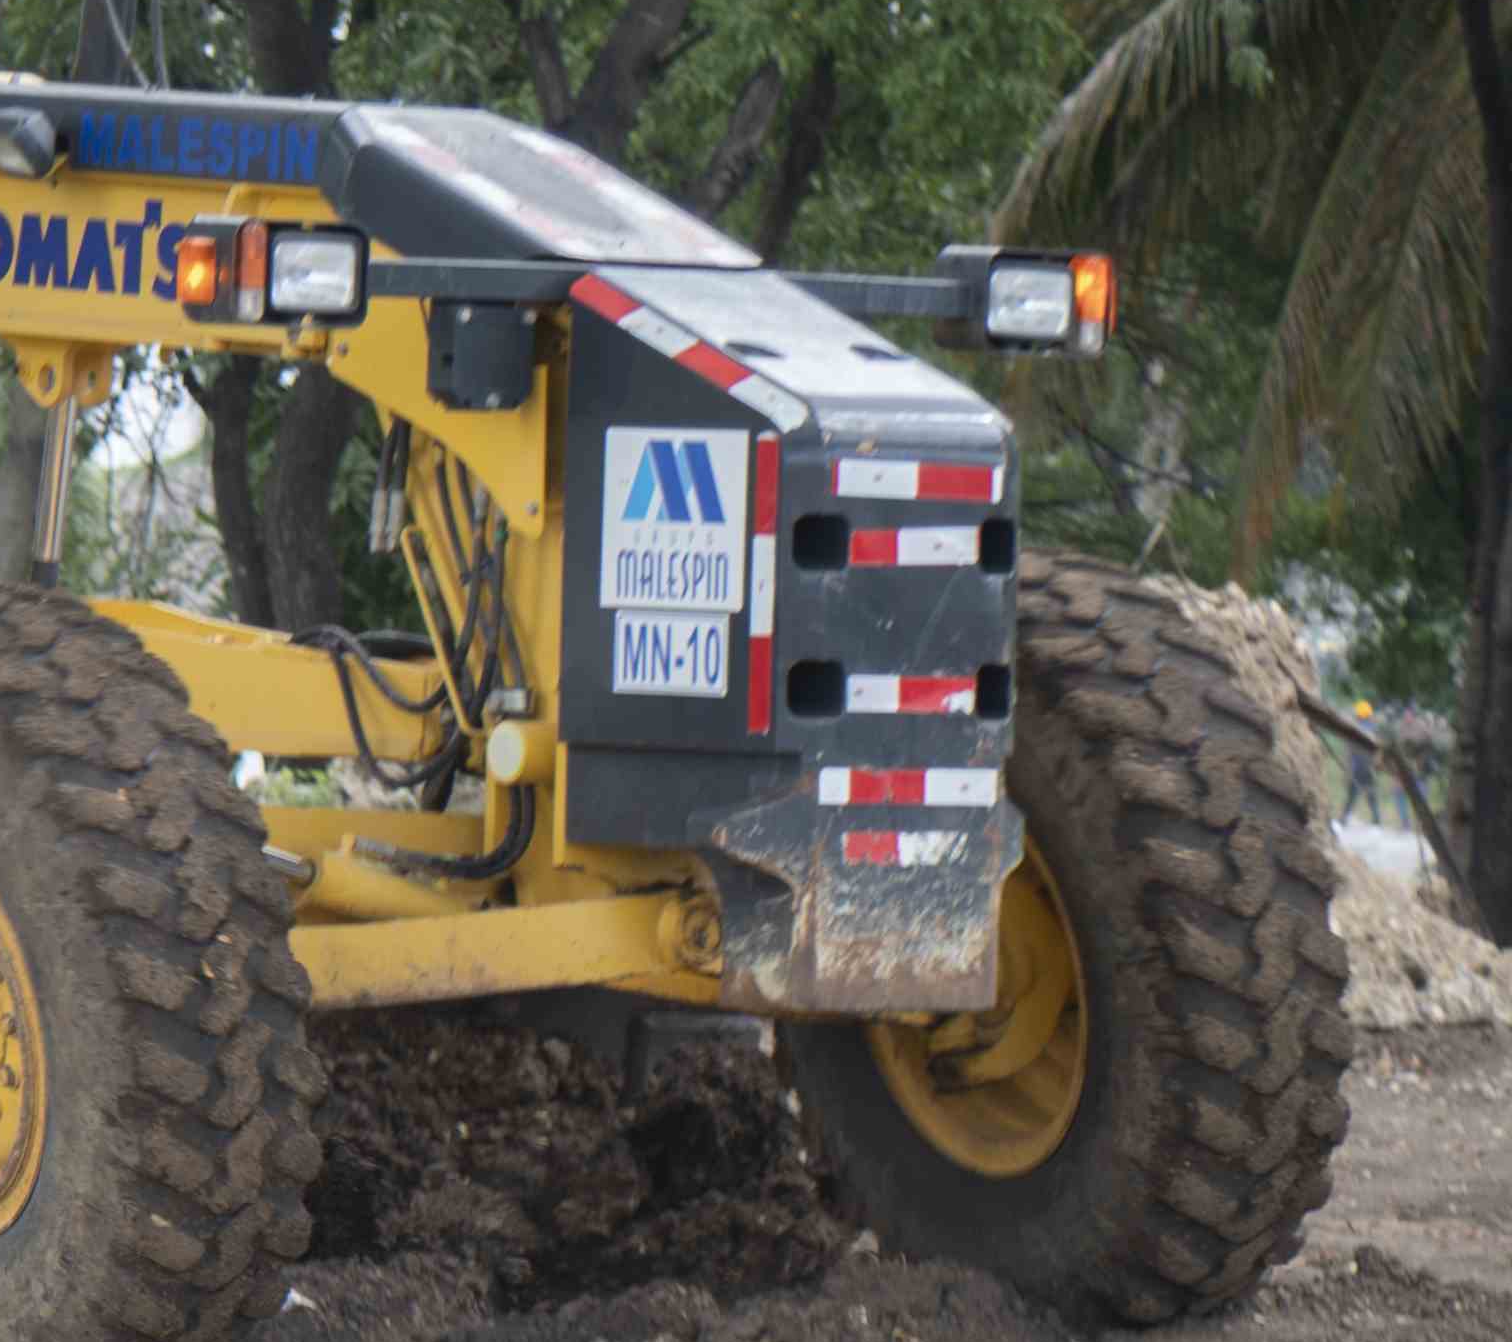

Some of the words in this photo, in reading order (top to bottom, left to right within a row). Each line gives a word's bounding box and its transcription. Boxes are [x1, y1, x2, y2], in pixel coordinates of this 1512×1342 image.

[78, 108, 319, 182] MALESPIN
[616, 548, 728, 601] MALESPIN
[623, 622, 721, 686] MN-10
